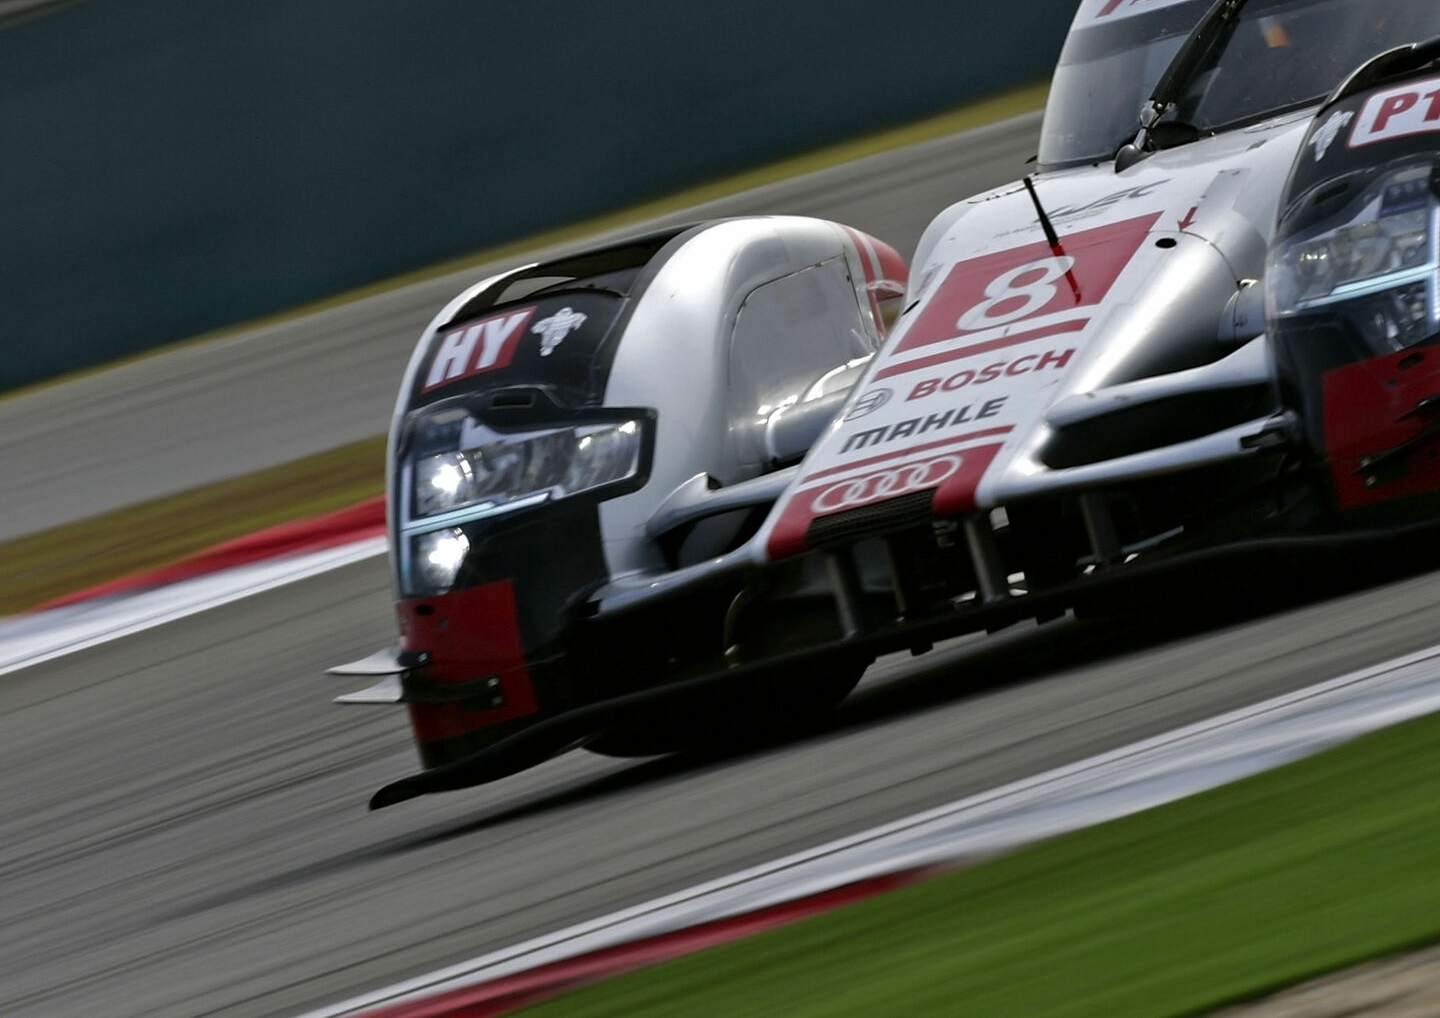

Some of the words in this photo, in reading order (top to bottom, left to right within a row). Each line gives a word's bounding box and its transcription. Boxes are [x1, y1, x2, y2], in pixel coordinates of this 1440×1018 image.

[955, 255, 1076, 332] 8
[425, 311, 531, 389] HY
[904, 347, 1077, 403] BOSCH
[837, 394, 1010, 455] MAHLE
